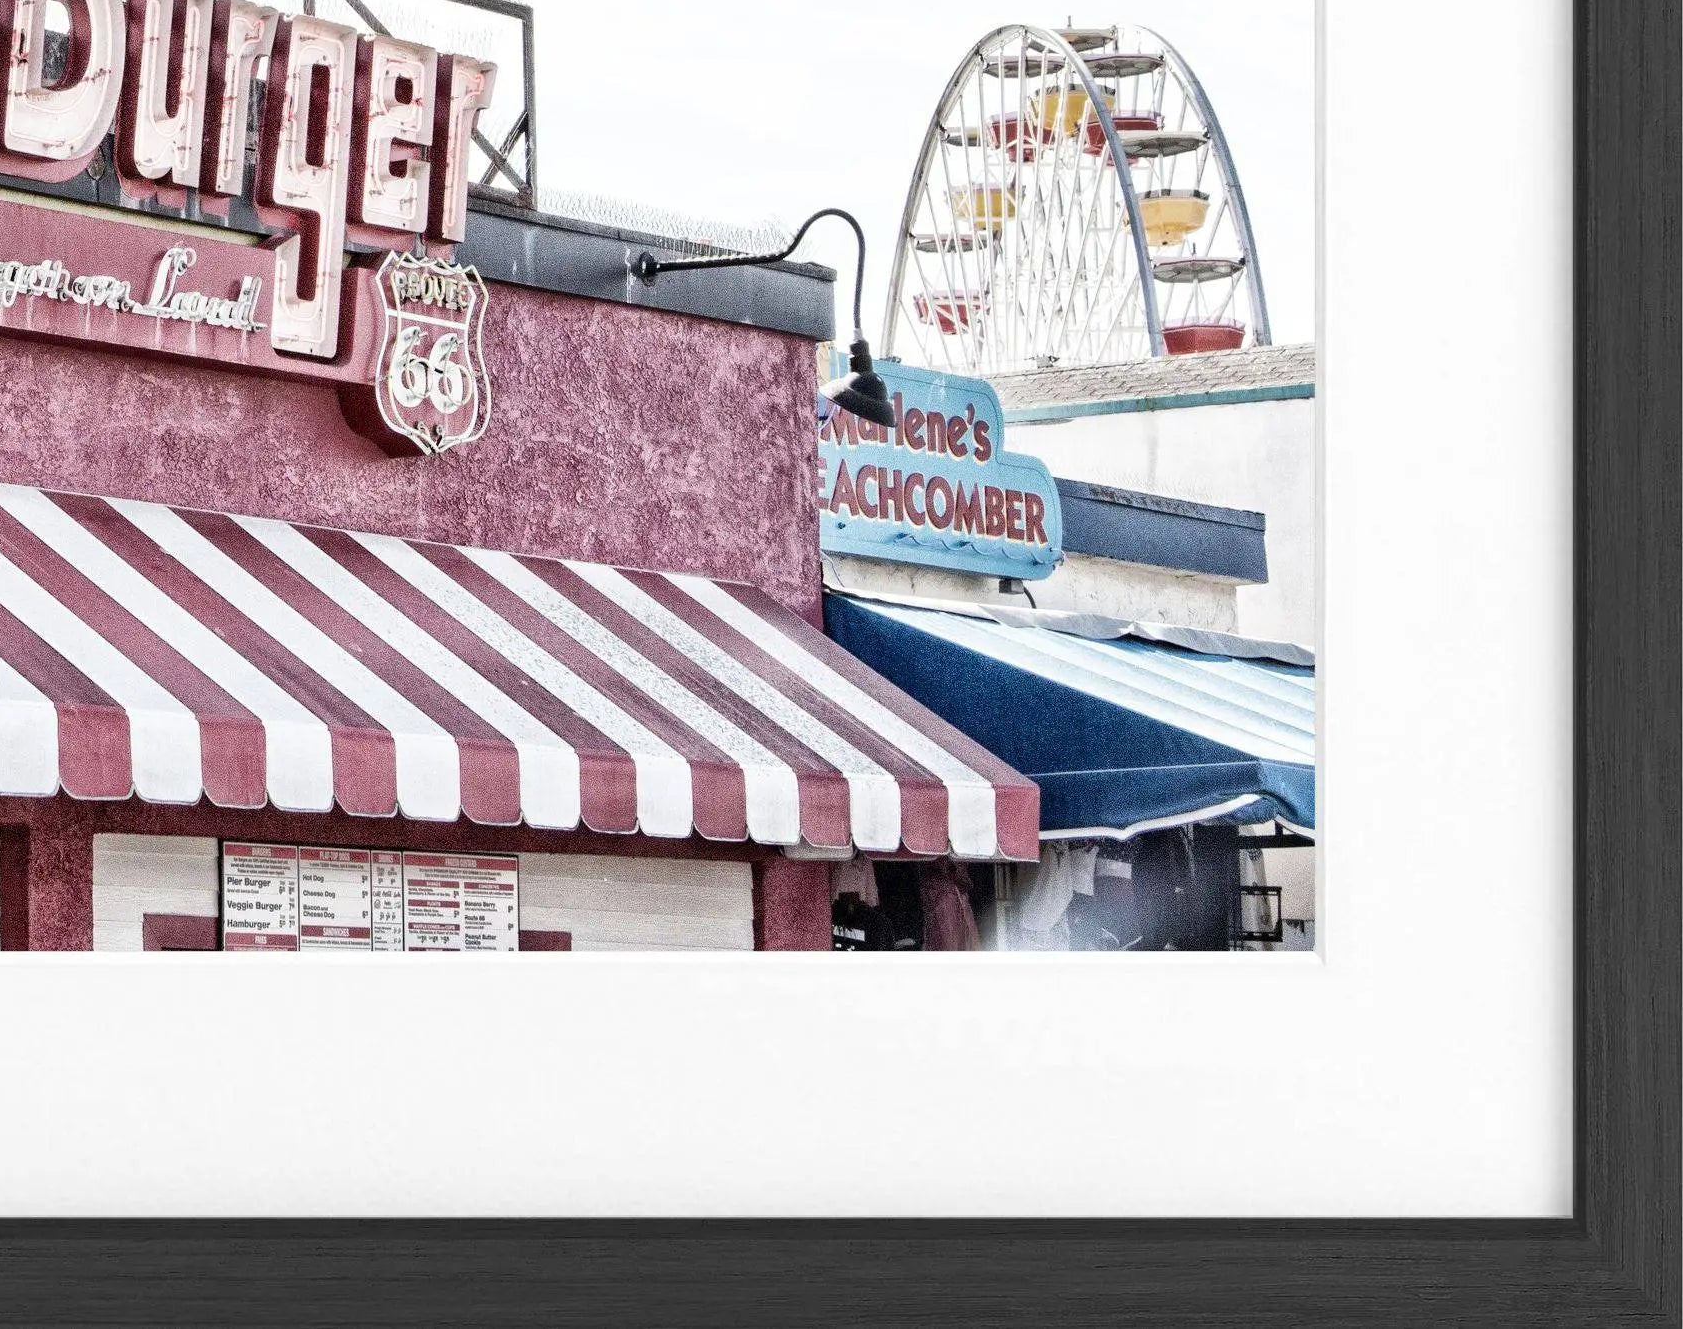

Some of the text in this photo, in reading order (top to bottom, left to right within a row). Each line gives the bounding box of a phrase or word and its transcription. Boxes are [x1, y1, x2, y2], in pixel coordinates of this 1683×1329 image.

[132, 246, 268, 331] Land
[394, 271, 469, 311] ROUTE
[392, 326, 473, 414] 66
[817, 458, 1048, 545] EACHCOMBER
[227, 877, 243, 886] Pier
[244, 878, 271, 888] Burger
[313, 875, 325, 883] Dog
[324, 891, 336, 899] Dog
[227, 900, 254, 911] Veggie
[255, 901, 283, 912] Burger
[324, 911, 335, 919] Dog
[227, 919, 271, 930] Hamburger
